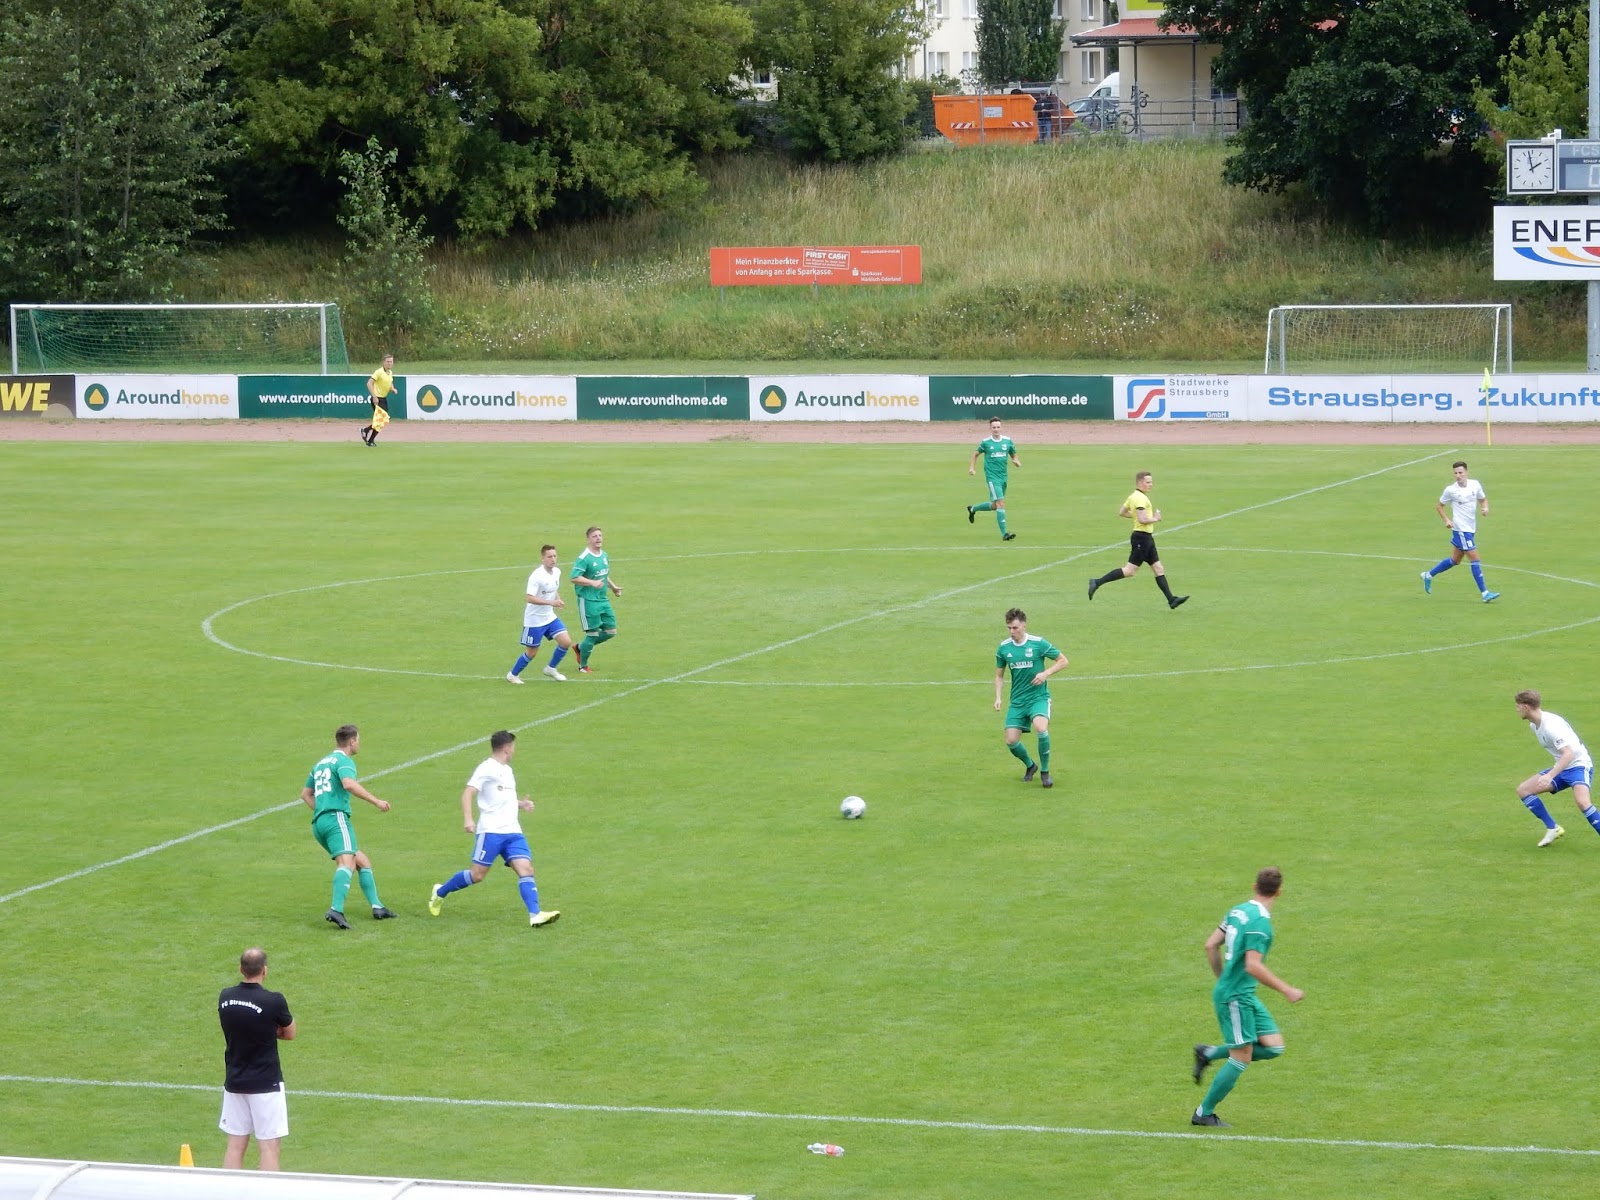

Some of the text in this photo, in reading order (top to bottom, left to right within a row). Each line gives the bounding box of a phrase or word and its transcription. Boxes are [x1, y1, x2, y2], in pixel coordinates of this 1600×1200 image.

[805, 251, 848, 260] FIRST CASH
[749, 268, 772, 277] Anfang
[785, 268, 797, 276] die
[797, 268, 833, 277] Sparkasse.
[1169, 378, 1229, 386] Stadtwerke
[116, 389, 230, 405] Aroundhome
[259, 392, 372, 404] www.aroundhome.
[448, 390, 568, 407] Aroundhome
[795, 390, 919, 407] Aroundhome
[1169, 388, 1229, 397] Strausberg
[1268, 387, 1600, 411] Strausberg. Zukunft
[598, 394, 728, 406] www.aroundhome.de
[952, 393, 1088, 406] www.aroundhome.de
[314, 768, 332, 798] 23
[221, 999, 263, 1014] FC Strausberg
